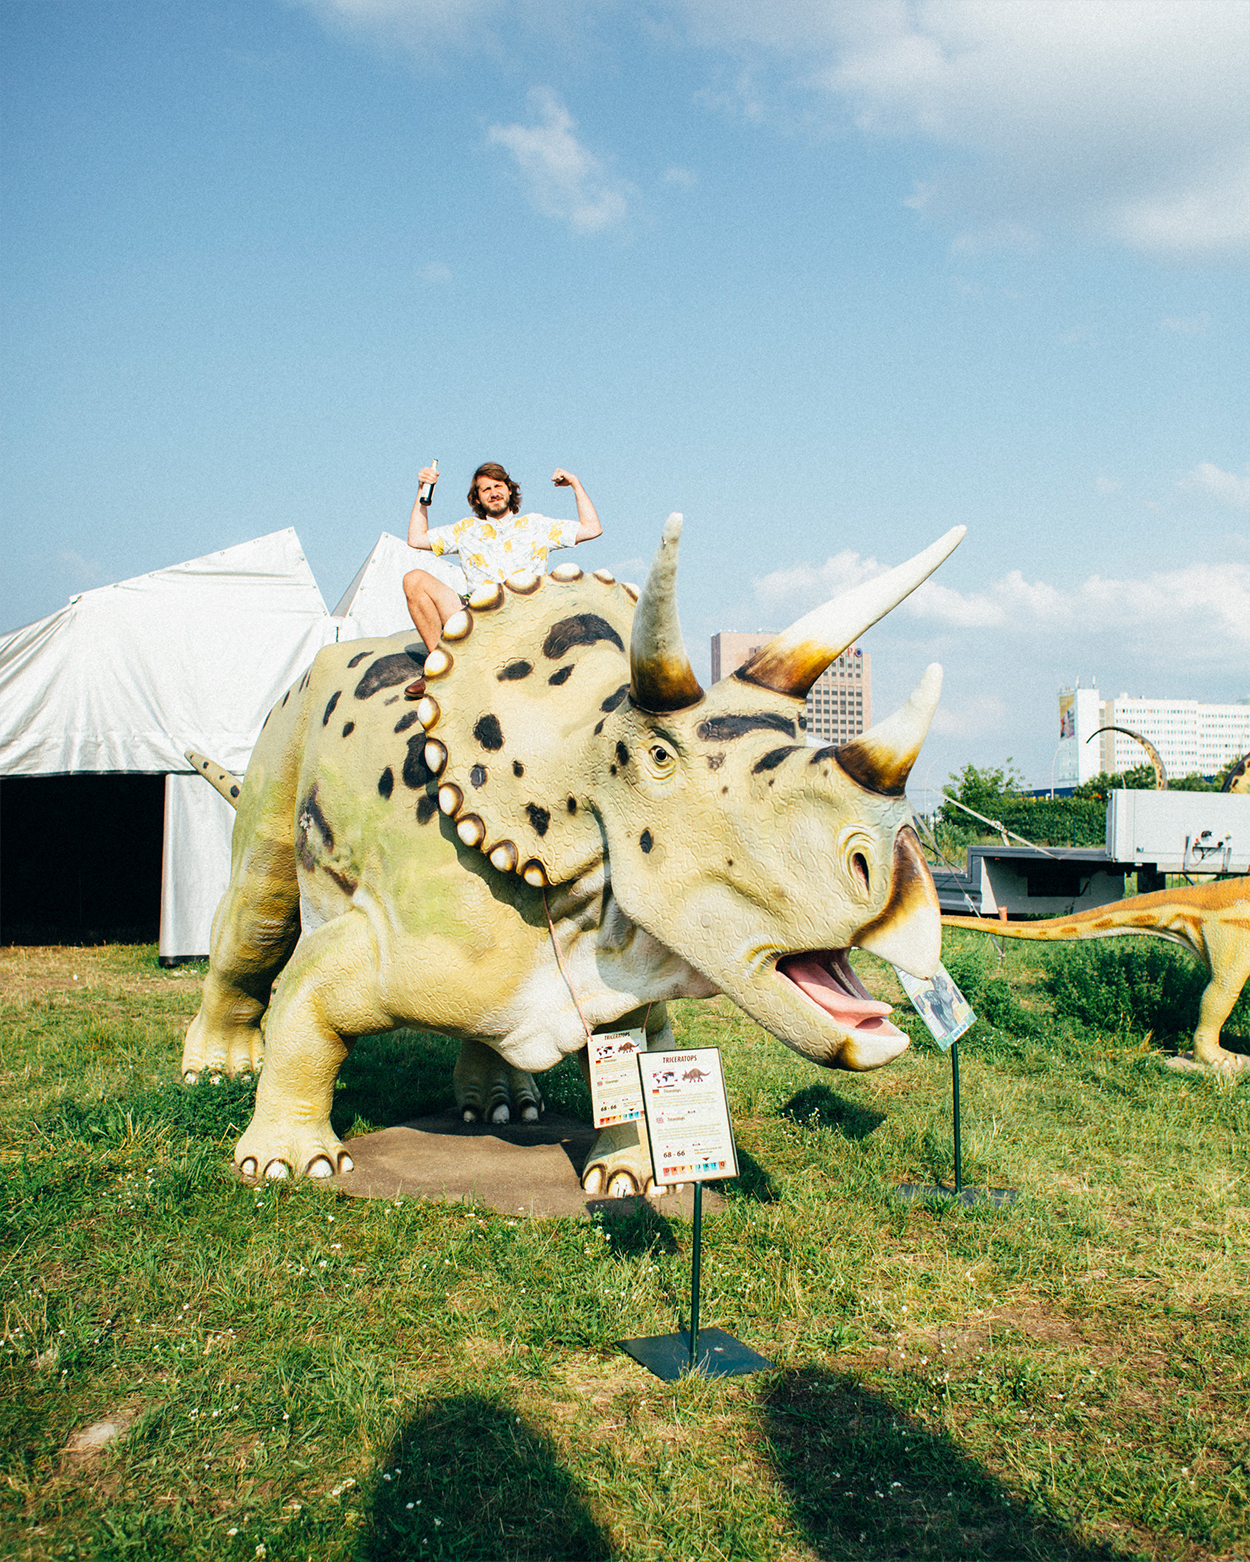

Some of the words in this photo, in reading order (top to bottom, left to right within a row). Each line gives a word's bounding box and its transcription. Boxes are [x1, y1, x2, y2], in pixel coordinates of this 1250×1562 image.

[604, 1031, 631, 1040] TRICERATOPS
[662, 1054, 697, 1063] TRICERATOPS
[663, 1151, 672, 1159] 68
[676, 1149, 686, 1157] 66
